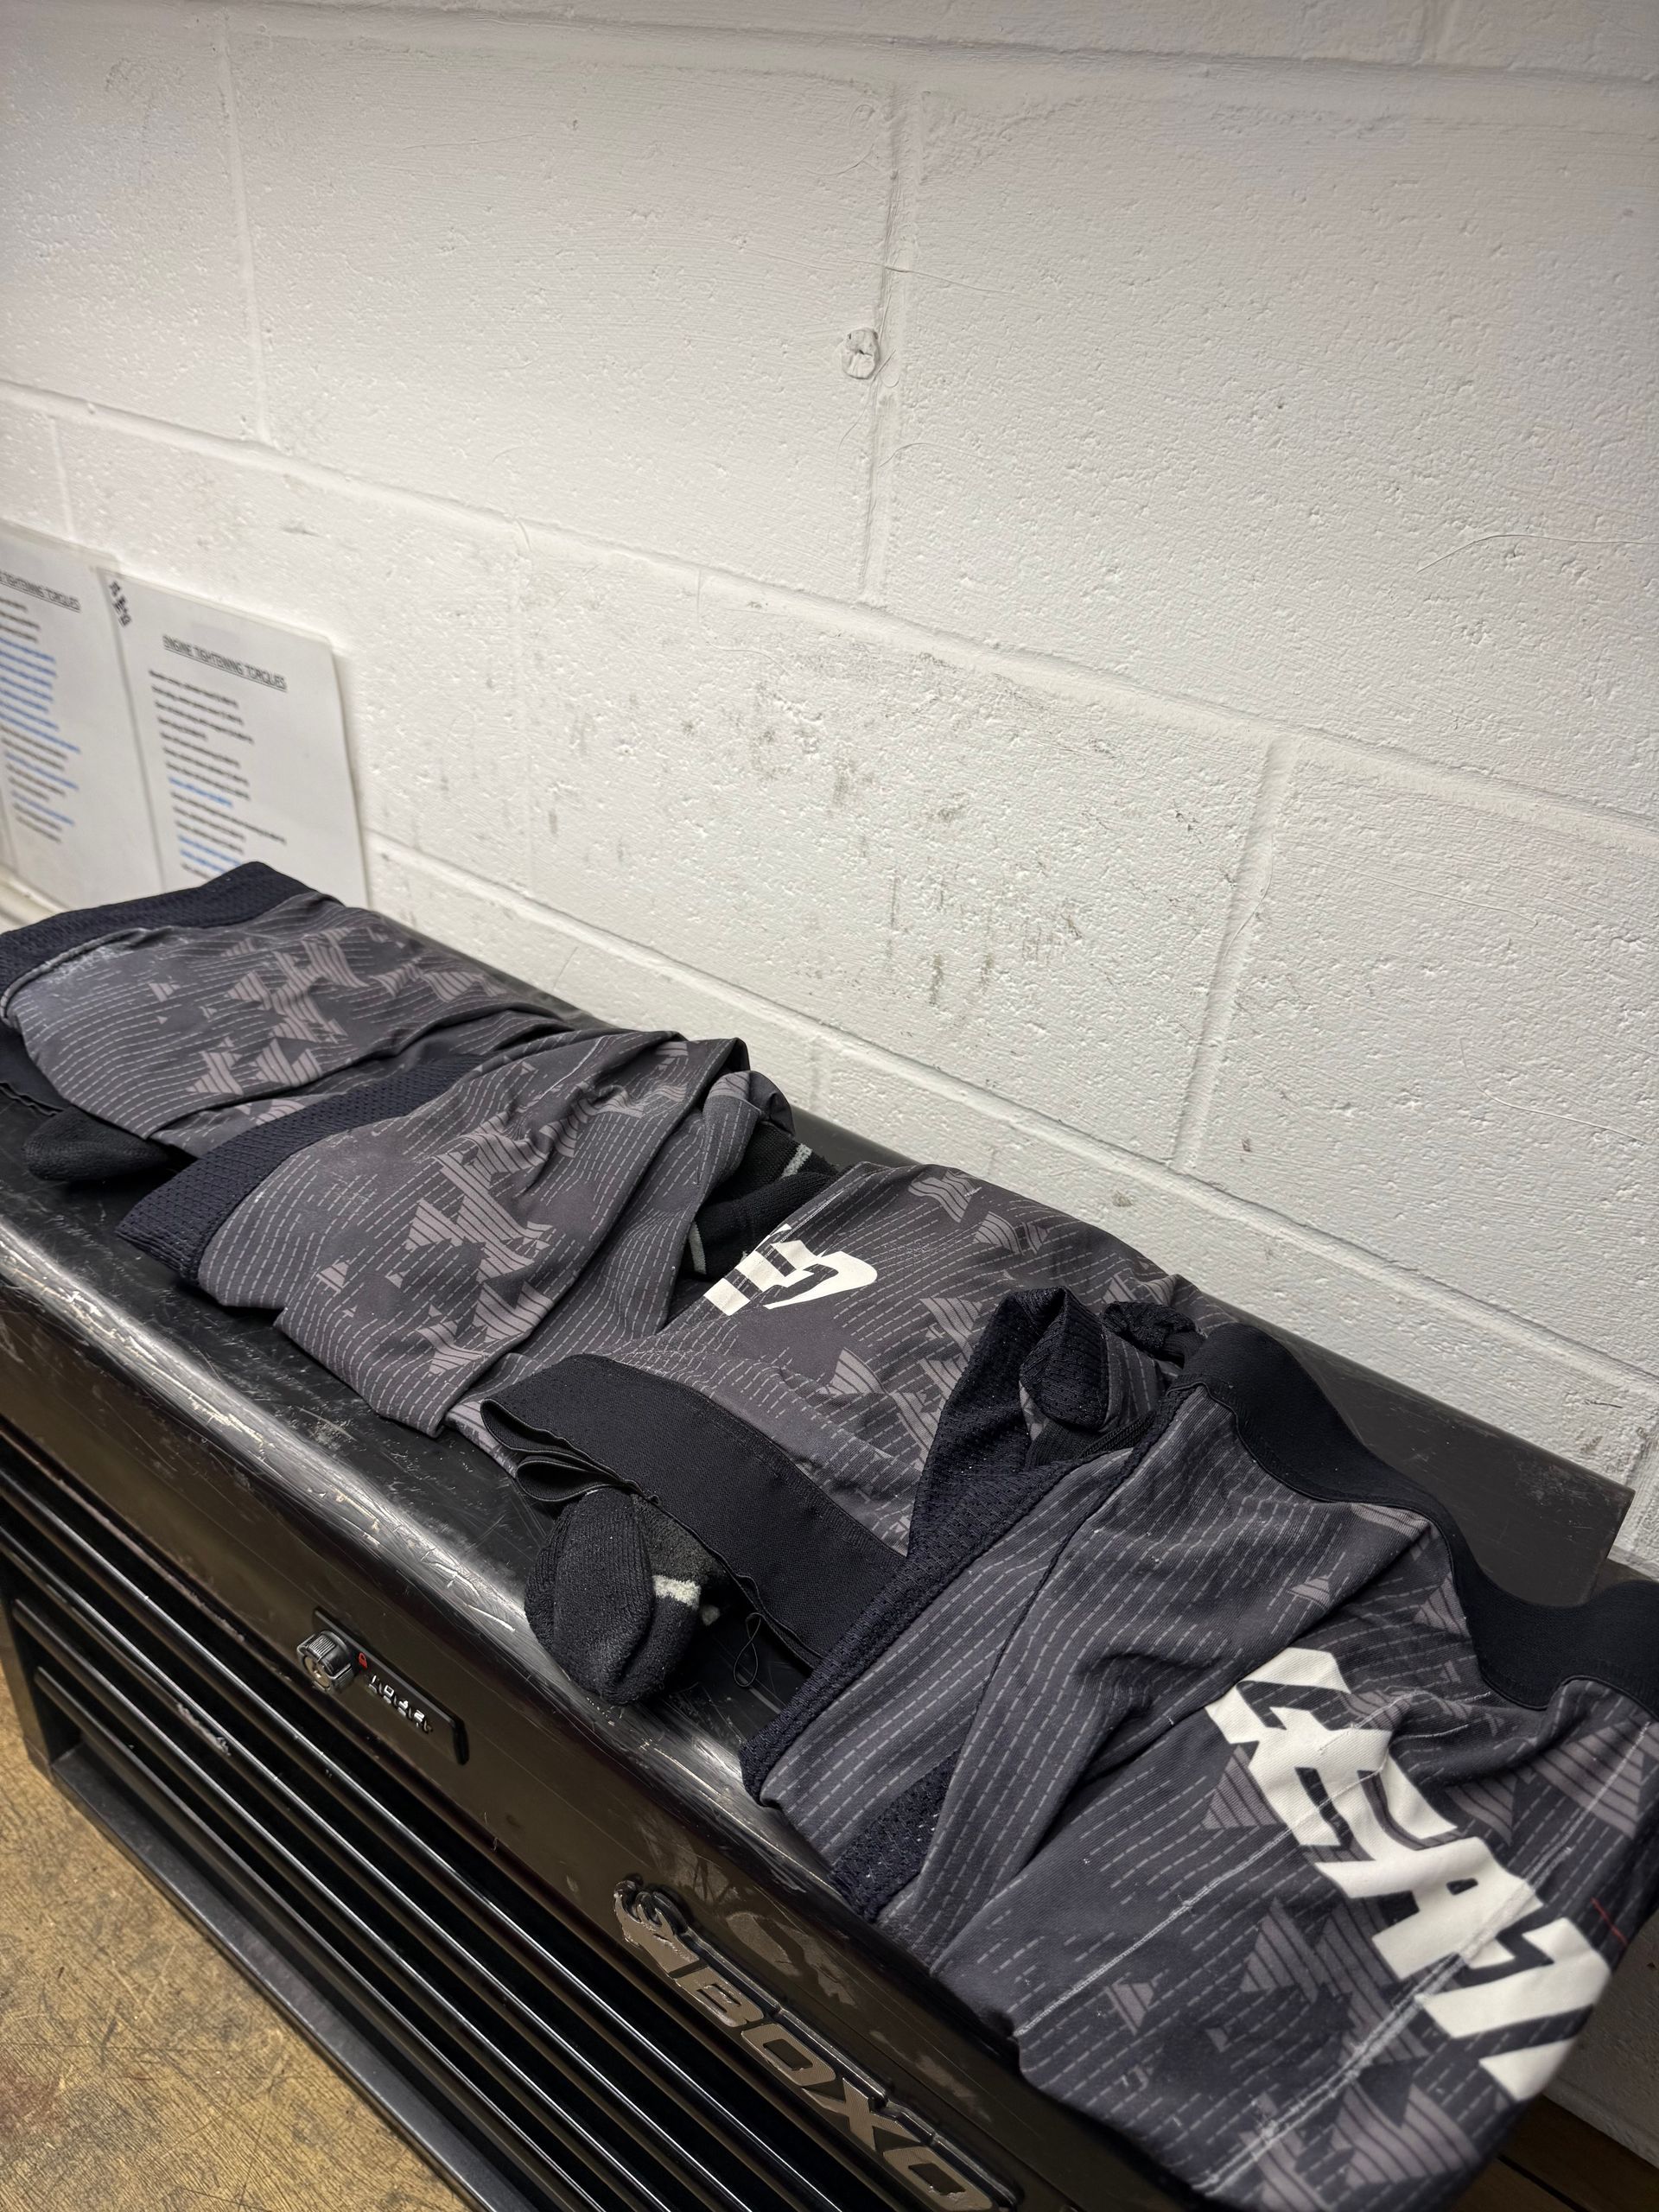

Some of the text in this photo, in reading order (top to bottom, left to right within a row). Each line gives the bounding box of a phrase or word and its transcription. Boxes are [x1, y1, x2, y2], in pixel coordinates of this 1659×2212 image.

[192, 646, 244, 675] TIGHTENING
[244, 664, 288, 690] TORQUES
[672, 1965, 993, 2210] BOXO
